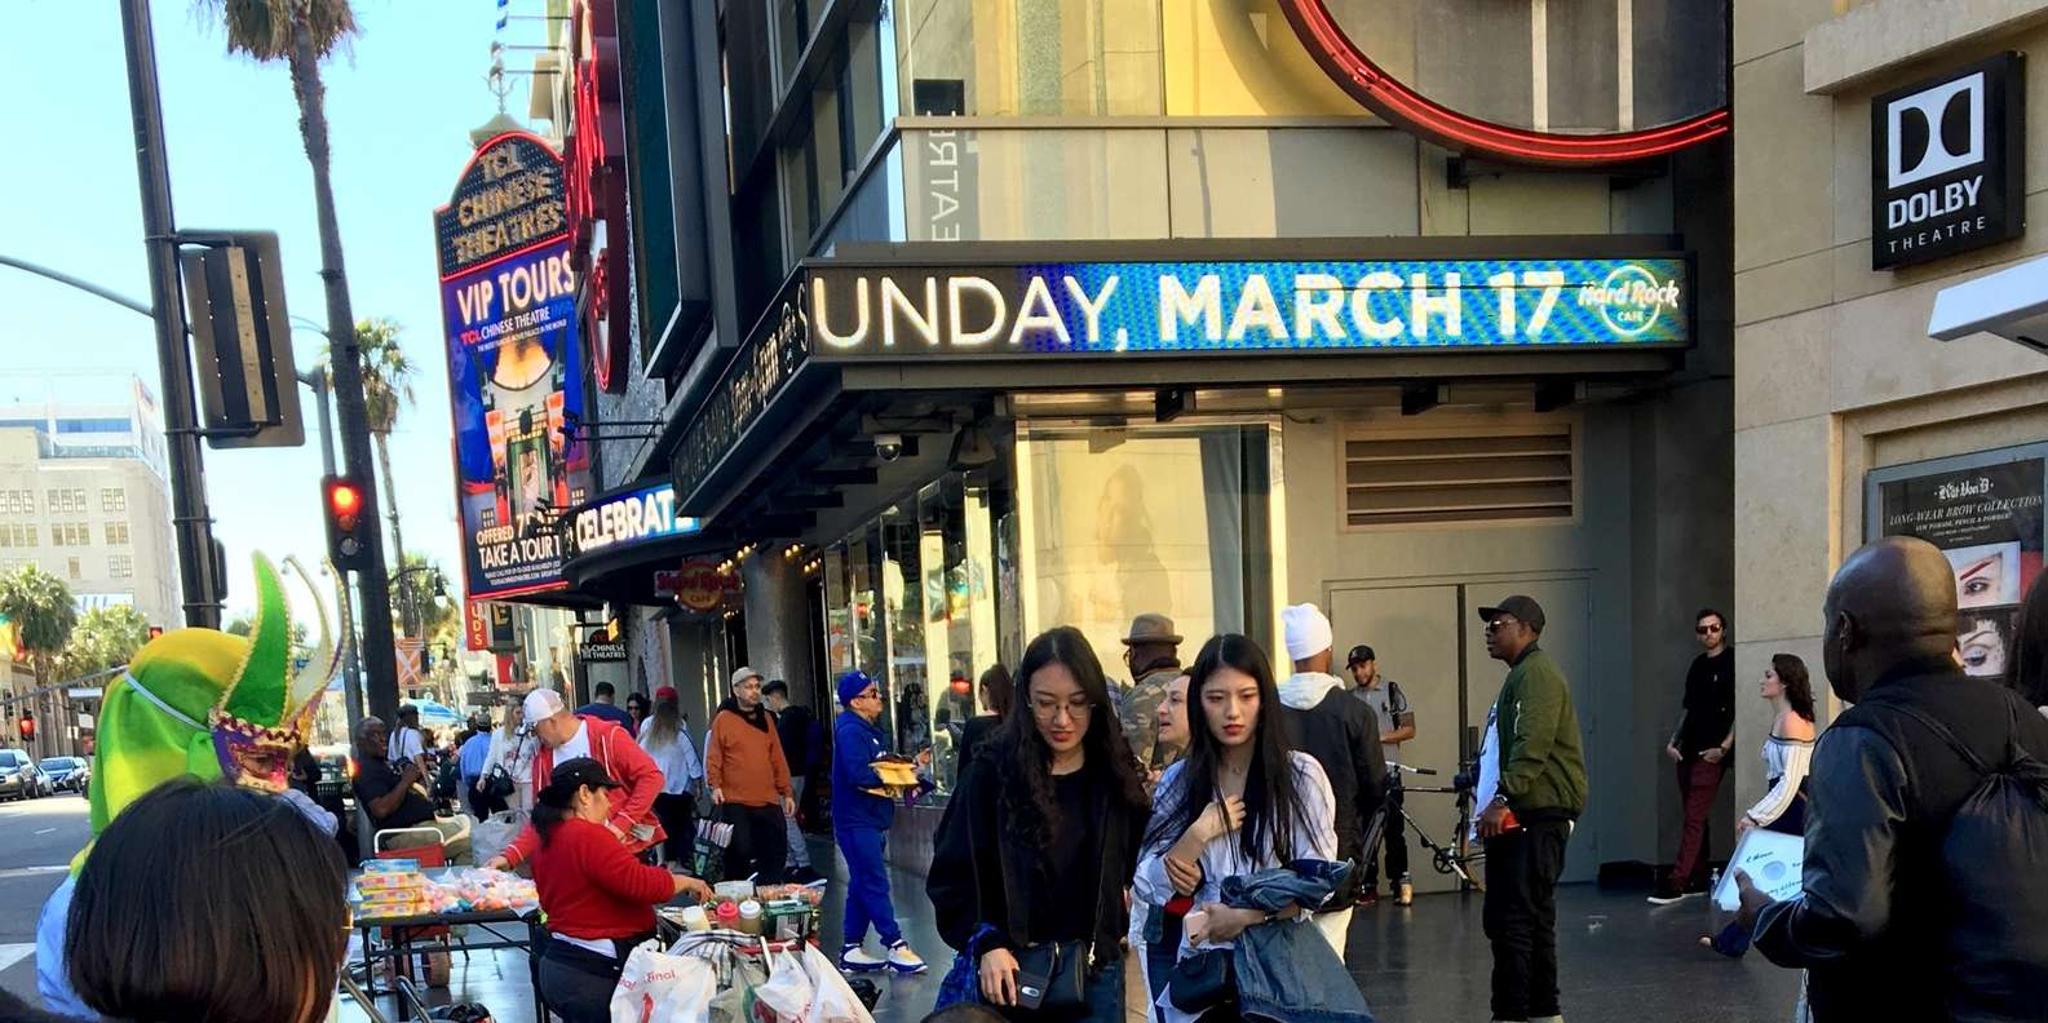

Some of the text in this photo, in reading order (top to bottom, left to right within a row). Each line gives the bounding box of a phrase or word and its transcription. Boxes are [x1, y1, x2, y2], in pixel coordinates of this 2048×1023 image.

[479, 144, 524, 183] TCL
[458, 166, 553, 228] CHINESE
[1888, 175, 1984, 230] DOLBY
[451, 200, 563, 264] THEATRES
[1888, 216, 1986, 253] THEATRE
[457, 280, 493, 325] VIP
[498, 250, 575, 312] TOURS
[1159, 271, 1462, 342] MARCH
[1488, 270, 1565, 337] 17
[1577, 278, 1680, 308] Hard Rock
[481, 317, 514, 340] CHINESE
[515, 306, 551, 329] THEATRE
[576, 488, 694, 552] CELEBRAT
[1946, 504, 1976, 517] BROW
[1977, 495, 2042, 514] COLLECTION
[476, 525, 514, 545] OFFERED
[478, 543, 509, 569] TAKE
[510, 541, 521, 564] A
[520, 535, 554, 562] TOUR
[591, 643, 625, 652] CHINESE
